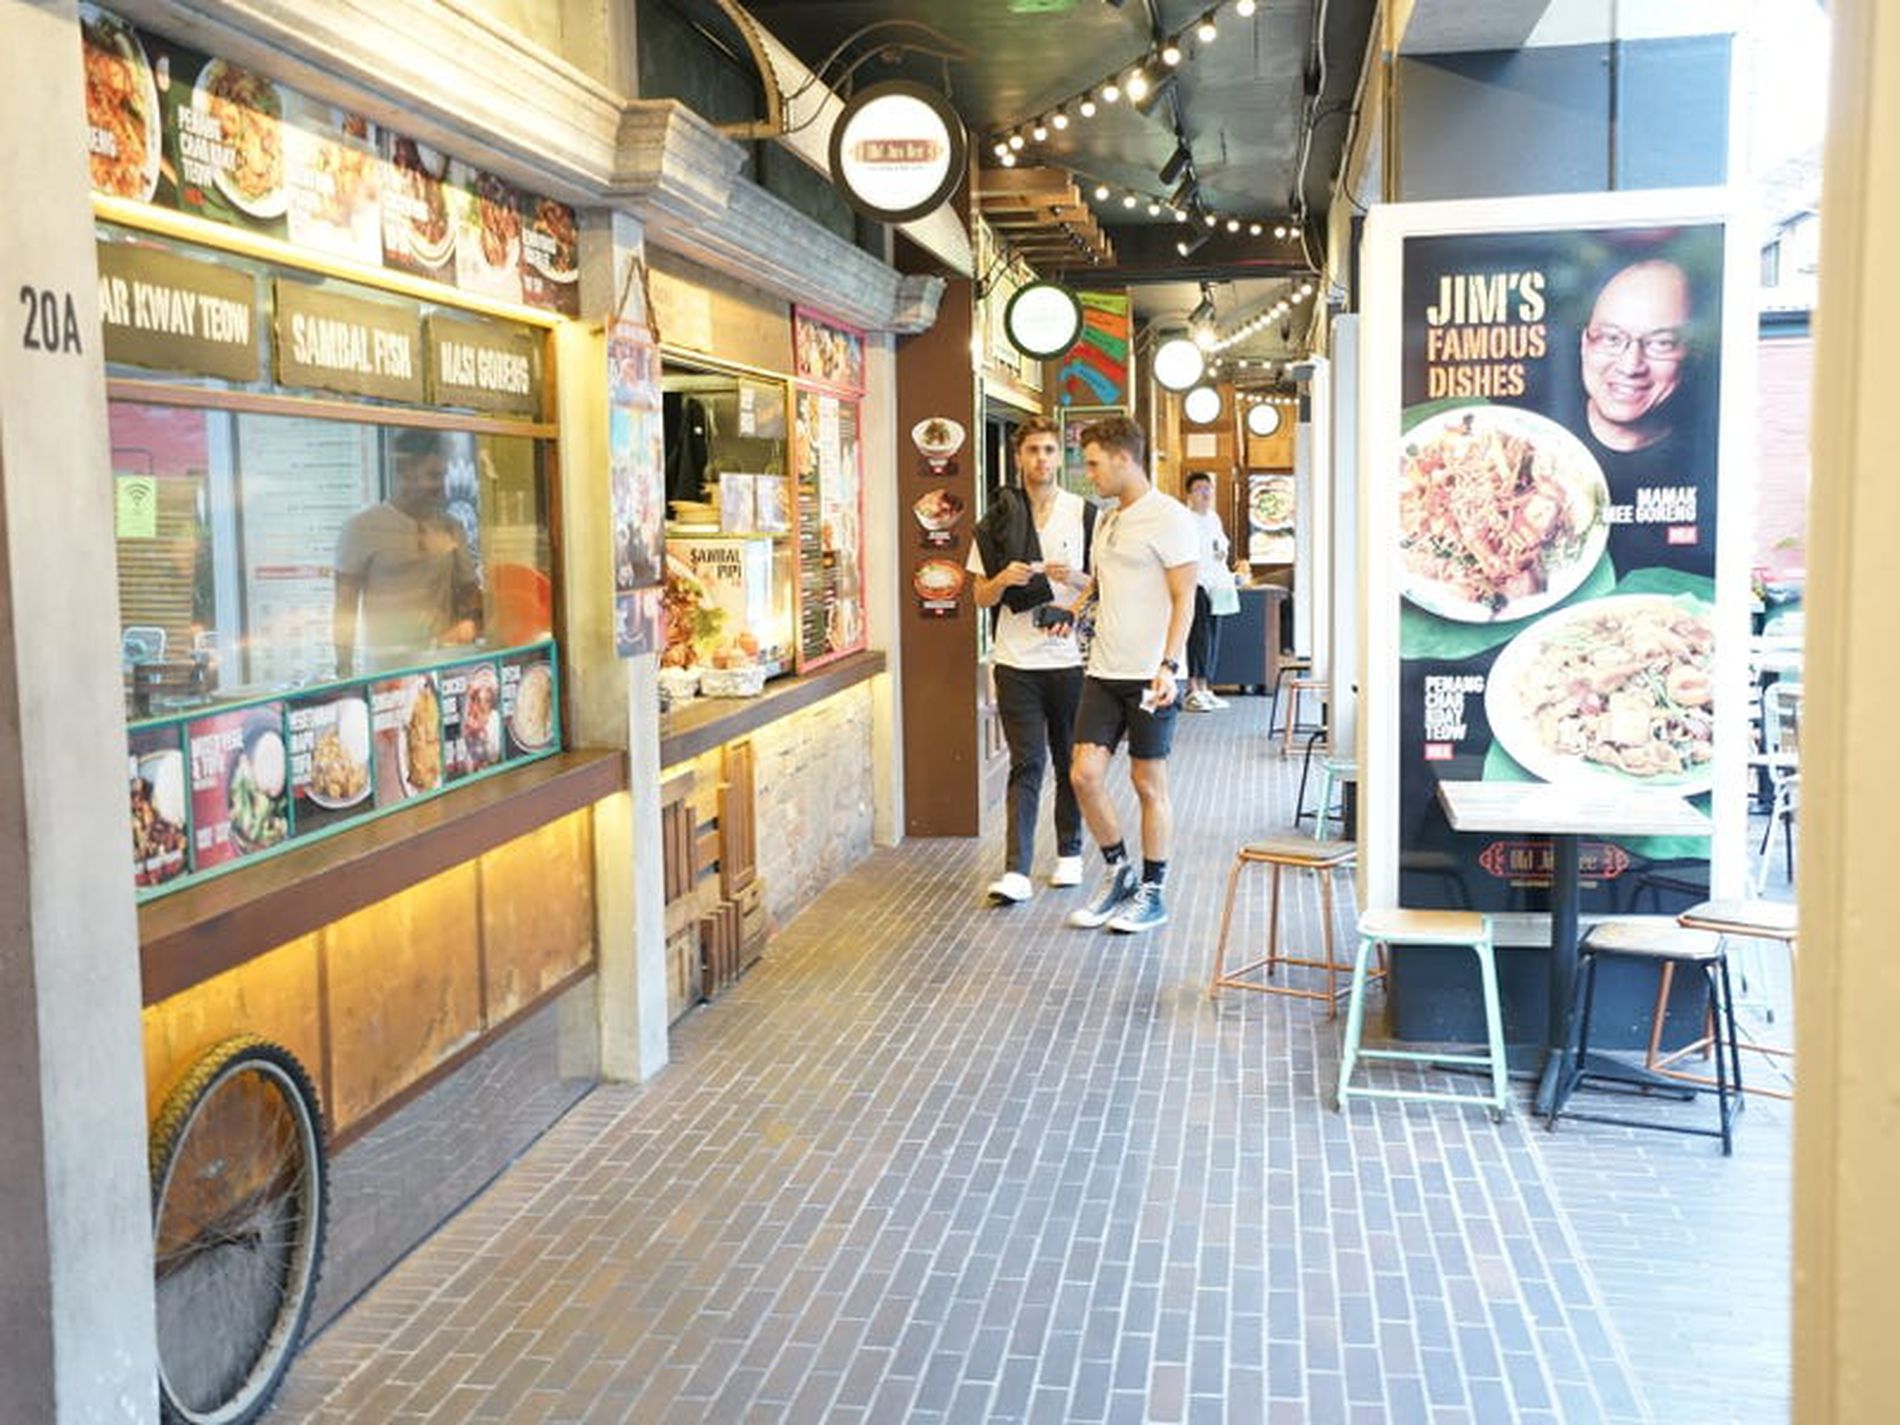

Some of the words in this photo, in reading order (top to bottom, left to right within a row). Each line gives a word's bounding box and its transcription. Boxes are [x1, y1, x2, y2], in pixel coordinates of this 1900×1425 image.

[19, 286, 82, 355] 20A
[133, 280, 196, 337] KWAY
[199, 294, 249, 346] TEOW
[1426, 271, 1546, 326] JIM'S
[292, 312, 373, 372] SAMBAL
[374, 327, 412, 380] FISH
[440, 341, 476, 386] NASI
[1427, 324, 1547, 361] FAMOUS
[1428, 362, 1525, 399] DISHES
[1636, 486, 1697, 506] MAMAK
